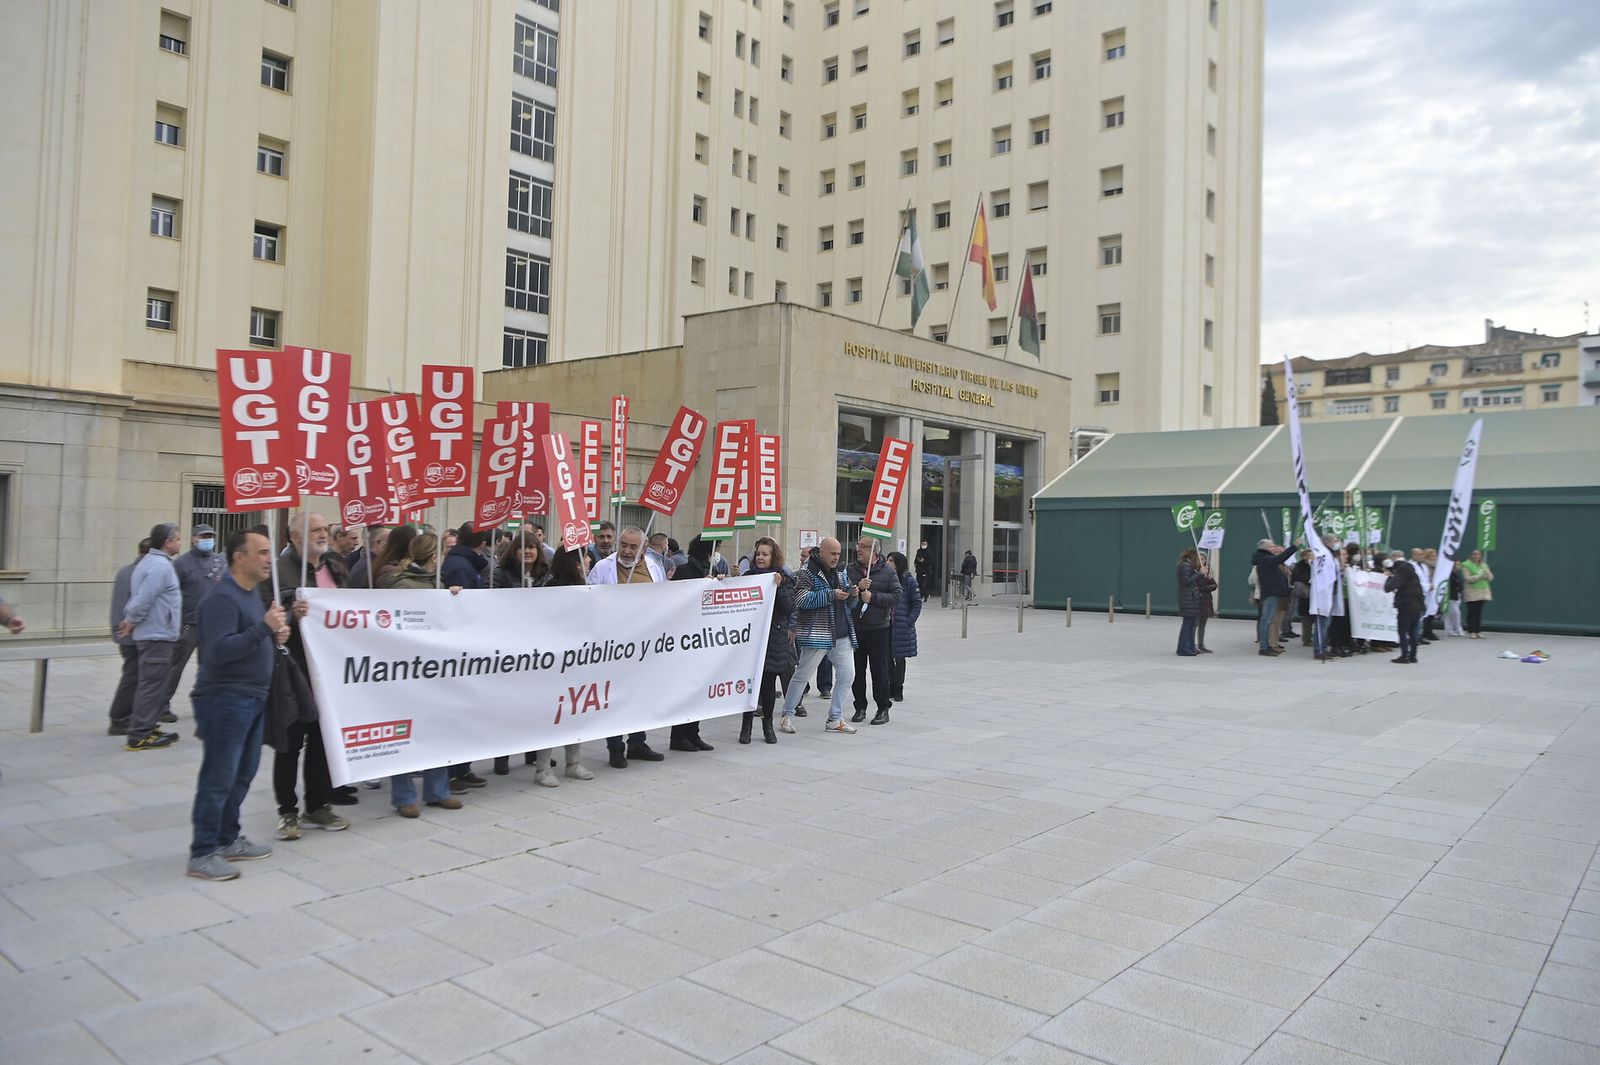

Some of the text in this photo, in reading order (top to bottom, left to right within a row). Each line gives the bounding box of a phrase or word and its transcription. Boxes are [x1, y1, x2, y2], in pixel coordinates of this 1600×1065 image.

[297, 349, 332, 459] UGT
[844, 341, 1039, 399] HOSPITAL UNIVERSITARIO VIRGEN DE LAS NIEVES
[911, 379, 995, 407] HOSPITAL GENERAL
[229, 357, 280, 465] UGT
[381, 400, 417, 479] UGT
[430, 371, 464, 460] UGT
[665, 413, 704, 485] UGT
[346, 402, 373, 497] UGT
[488, 420, 519, 498] UGT
[551, 433, 576, 520] UGT
[584, 424, 598, 518] CCOO
[710, 426, 740, 525] CCOO
[760, 437, 776, 511] CCOO
[871, 441, 907, 526] CCOO
[324, 609, 370, 629] UGT
[715, 591, 750, 601] CCOO
[344, 623, 751, 685] Mantenimiento público y de calidad
[708, 681, 733, 699] UGT
[344, 725, 395, 744] CCOO
[554, 680, 611, 725] ¡YA!
